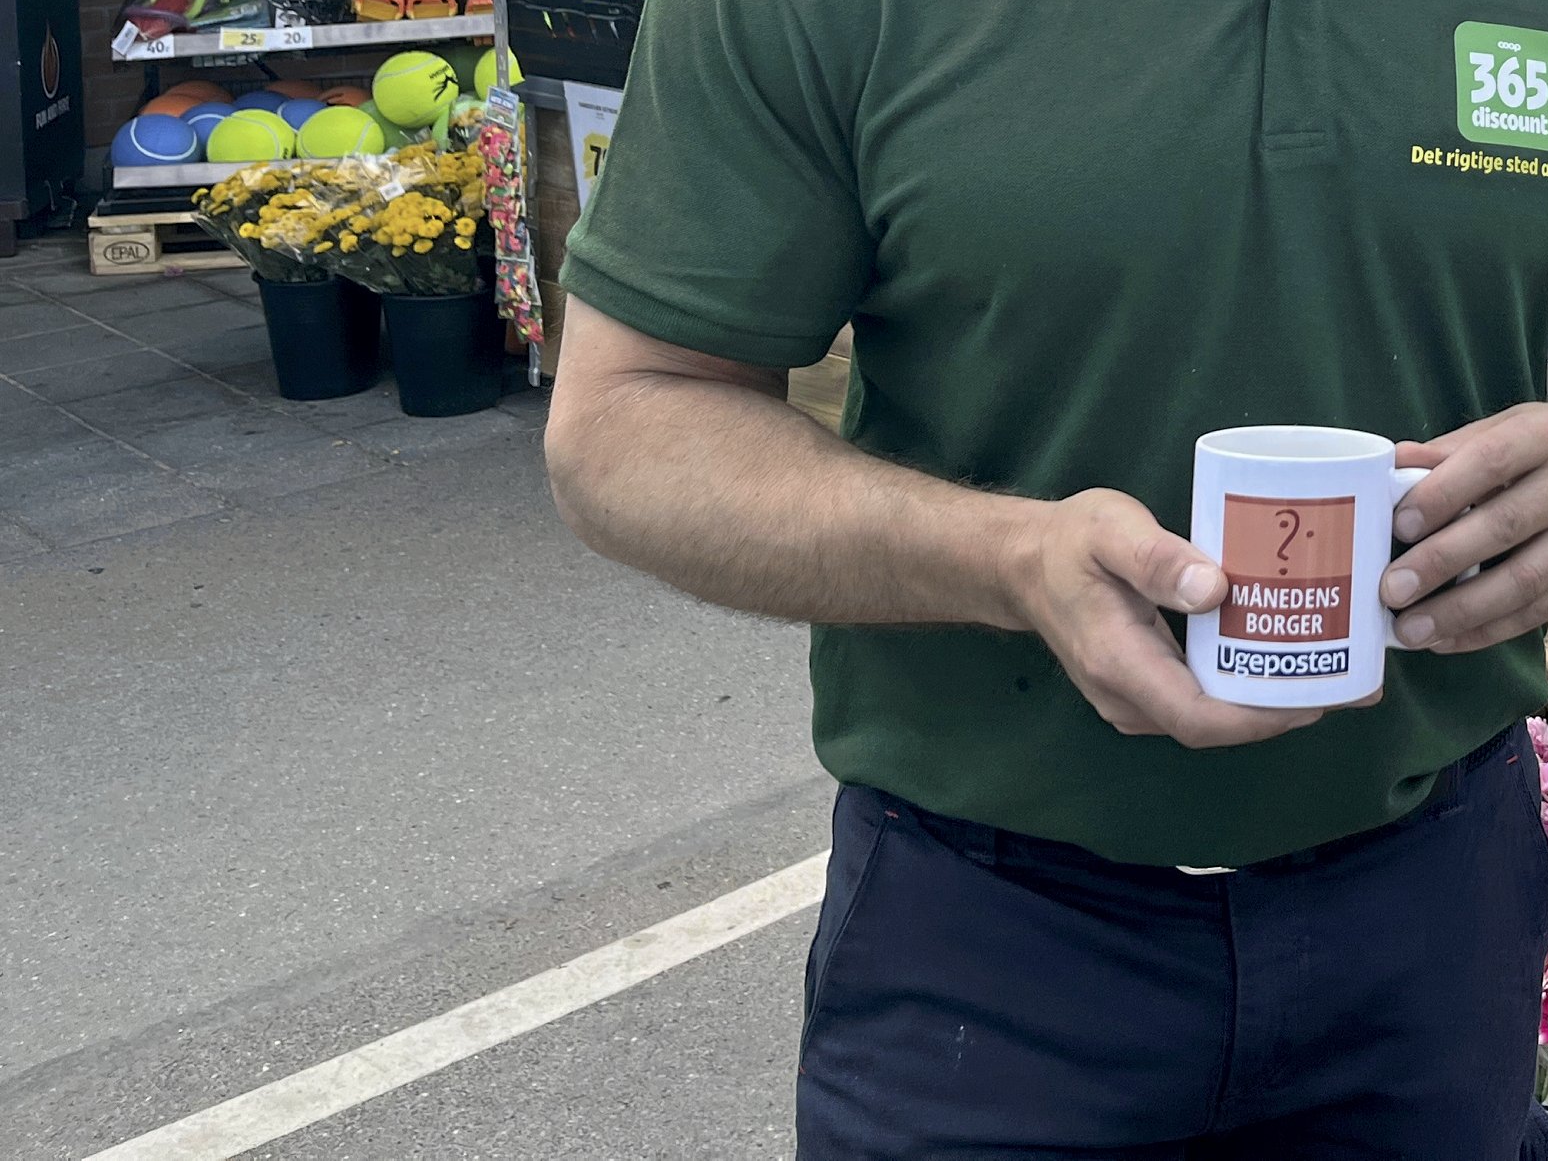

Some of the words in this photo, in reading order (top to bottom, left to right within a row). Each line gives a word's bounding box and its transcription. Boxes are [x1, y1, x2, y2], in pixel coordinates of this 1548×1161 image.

[1497, 40, 1521, 52] coop
[1469, 51, 1548, 110] 365
[1471, 106, 1548, 135] discount
[1411, 145, 1443, 165] Det
[1446, 148, 1503, 174] rigtige
[1506, 156, 1538, 175] sted
[111, 245, 143, 260] EPAL
[1231, 582, 1340, 608] MÅNEDENS
[1246, 612, 1323, 636] BORGER
[1218, 643, 1349, 678] Ugeposten
